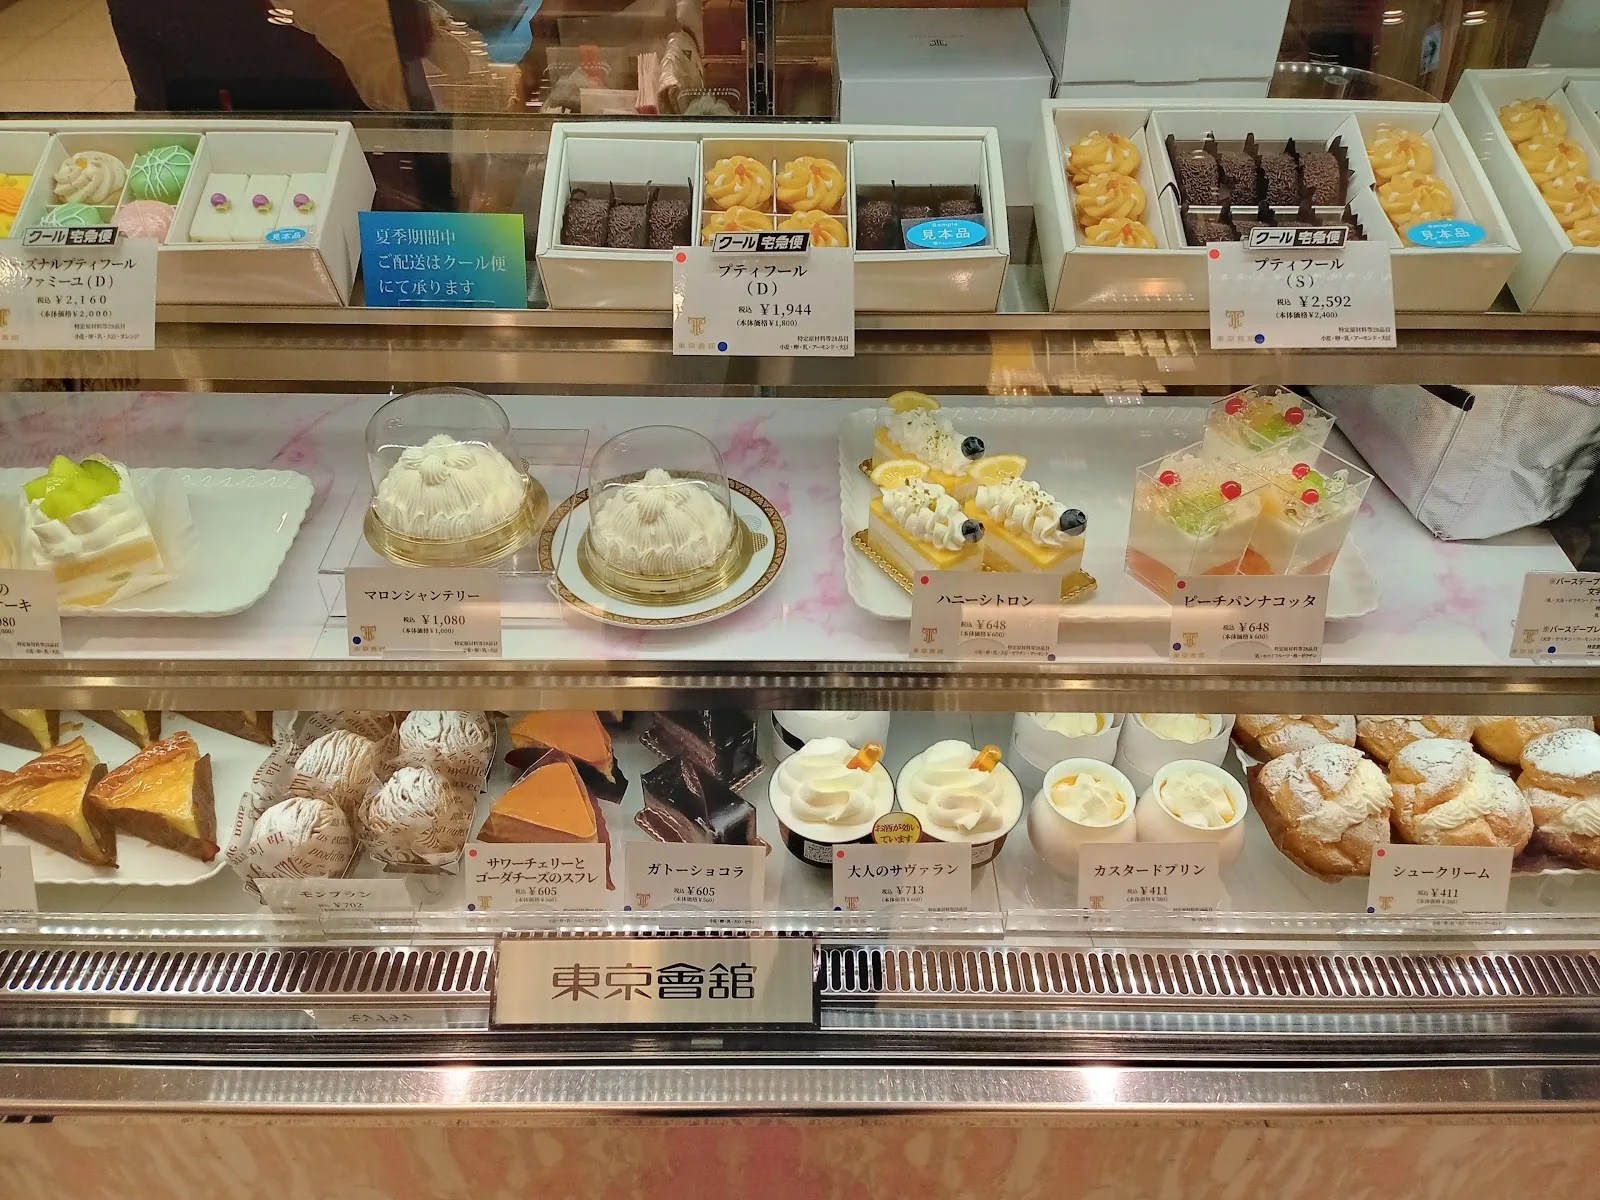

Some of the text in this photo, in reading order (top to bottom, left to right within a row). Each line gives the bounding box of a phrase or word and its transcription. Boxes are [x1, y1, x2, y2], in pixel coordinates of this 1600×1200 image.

[28, 229, 114, 243] クール宅急便
[374, 228, 456, 246] 夏季期間中
[921, 227, 970, 241] 見本品
[1256, 231, 1340, 245] クール宅急便
[1421, 227, 1470, 241] 見本品
[718, 235, 804, 250] クール宅急便
[22, 258, 137, 271] ズナルプティフール
[378, 253, 506, 272] ご配送はクール便
[1255, 257, 1345, 272] プティフール
[718, 262, 807, 278] プティフール
[379, 279, 475, 295] にて承ります
[1286, 274, 1315, 288] (S)
[747, 281, 778, 296] (D)
[55, 295, 108, 306] ¥2,160
[1299, 295, 1352, 310] ¥2,592
[760, 303, 812, 318] ¥1,944
[1275, 311, 1338, 319] (本体価格¥2,400)
[736, 319, 798, 327] (本体価格¥1,800)
[364, 590, 480, 602] マロンシャンテリー
[936, 594, 1034, 607] ハニーシトロン
[1184, 595, 1316, 608] ピーチパンナコッタ
[0, 599, 31, 612] ーキ
[421, 615, 466, 627] ¥1,080
[976, 620, 1006, 630] ¥648
[1239, 622, 1270, 632] ¥648
[880, 835, 913, 843] ています
[487, 857, 584, 870] サワーチェリーと
[647, 863, 745, 878] ガトーショコラ
[847, 864, 959, 879] 大人のサヴァラン
[1094, 864, 1206, 877] カスタードプリン
[1393, 866, 1490, 879] シュークリーム
[475, 872, 599, 884] ゴーダチーズのスフレ
[299, 890, 372, 898] モンブラン
[528, 886, 557, 896] ¥605
[687, 886, 715, 896] ¥605
[896, 886, 924, 895] ¥713
[1140, 886, 1167, 895] ¥411
[1431, 888, 1458, 898] ¥411
[551, 962, 758, 1001] 東京會舘
